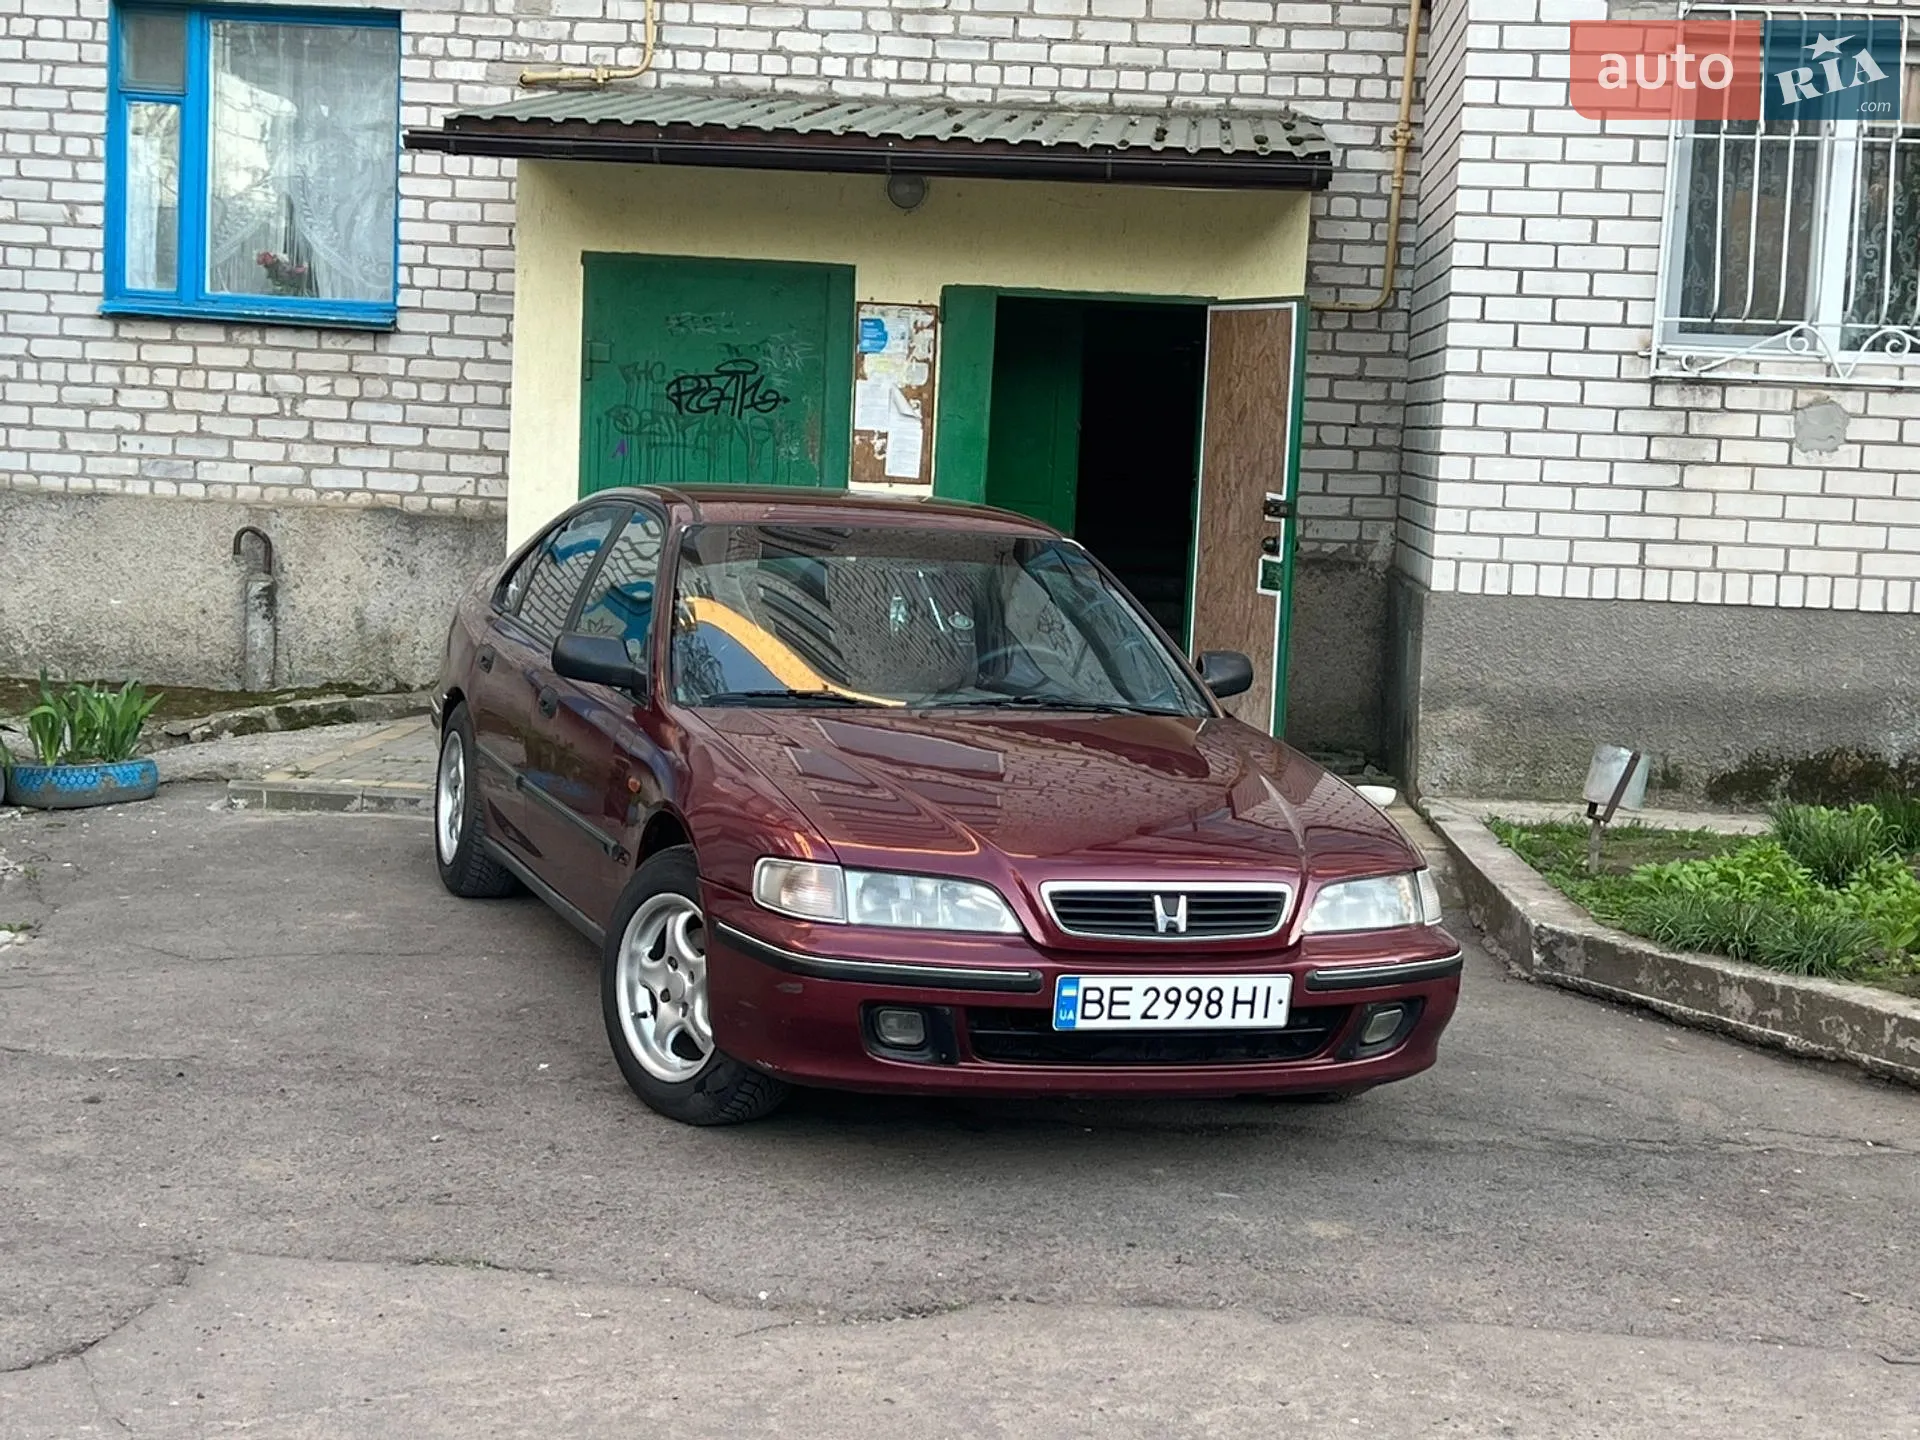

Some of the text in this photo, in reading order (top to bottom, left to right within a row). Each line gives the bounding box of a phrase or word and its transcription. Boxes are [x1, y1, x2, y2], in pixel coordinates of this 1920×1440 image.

[1060, 1008, 1075, 1021] UA
[1080, 986, 1272, 1020] BE 2998 HI
